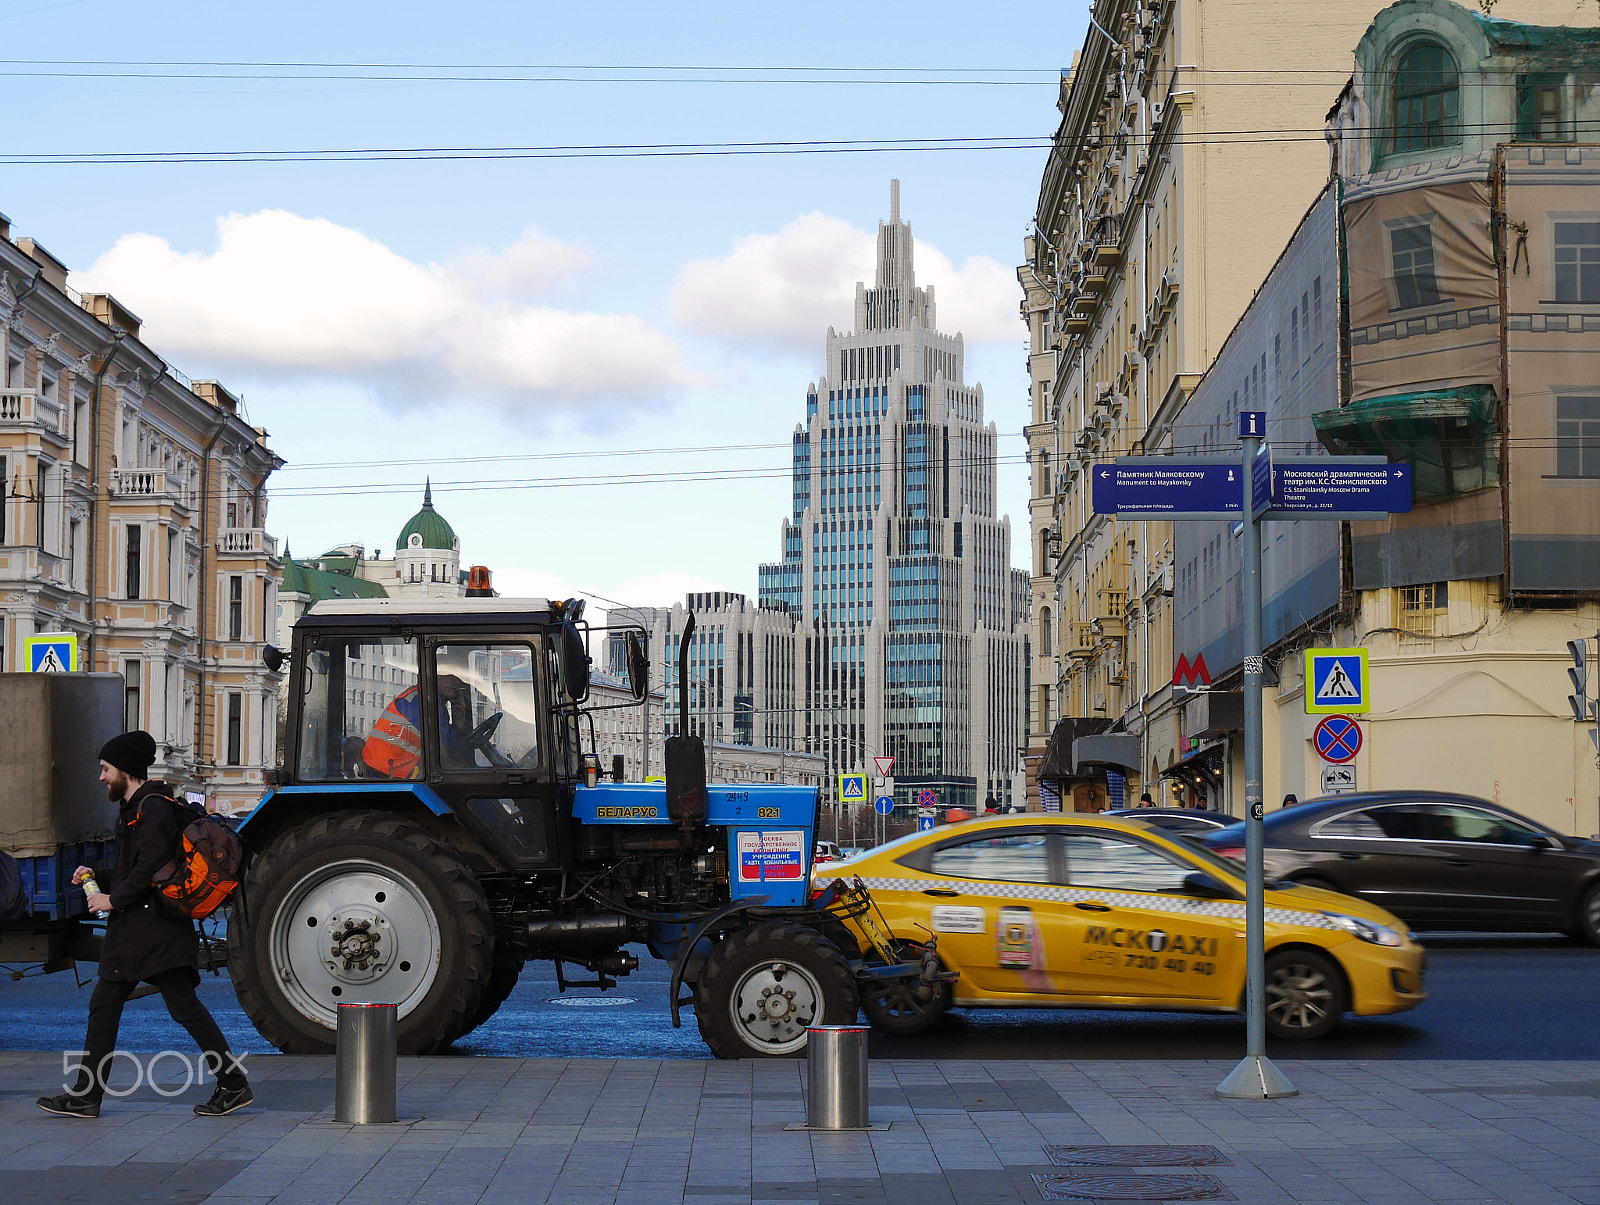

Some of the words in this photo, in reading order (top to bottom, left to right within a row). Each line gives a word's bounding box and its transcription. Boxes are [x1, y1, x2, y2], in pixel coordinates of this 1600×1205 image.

[1116, 470, 1154, 478] Памятник
[1155, 470, 1205, 480] Маяковскому
[1283, 470, 1328, 478] Московский
[1329, 470, 1388, 479] драматический
[597, 806, 658, 818] БЕЛАРУС
[735, 807, 742, 815] 2
[1123, 953, 1159, 970] 730
[1163, 958, 1188, 973] 40
[1191, 961, 1216, 976] 40
